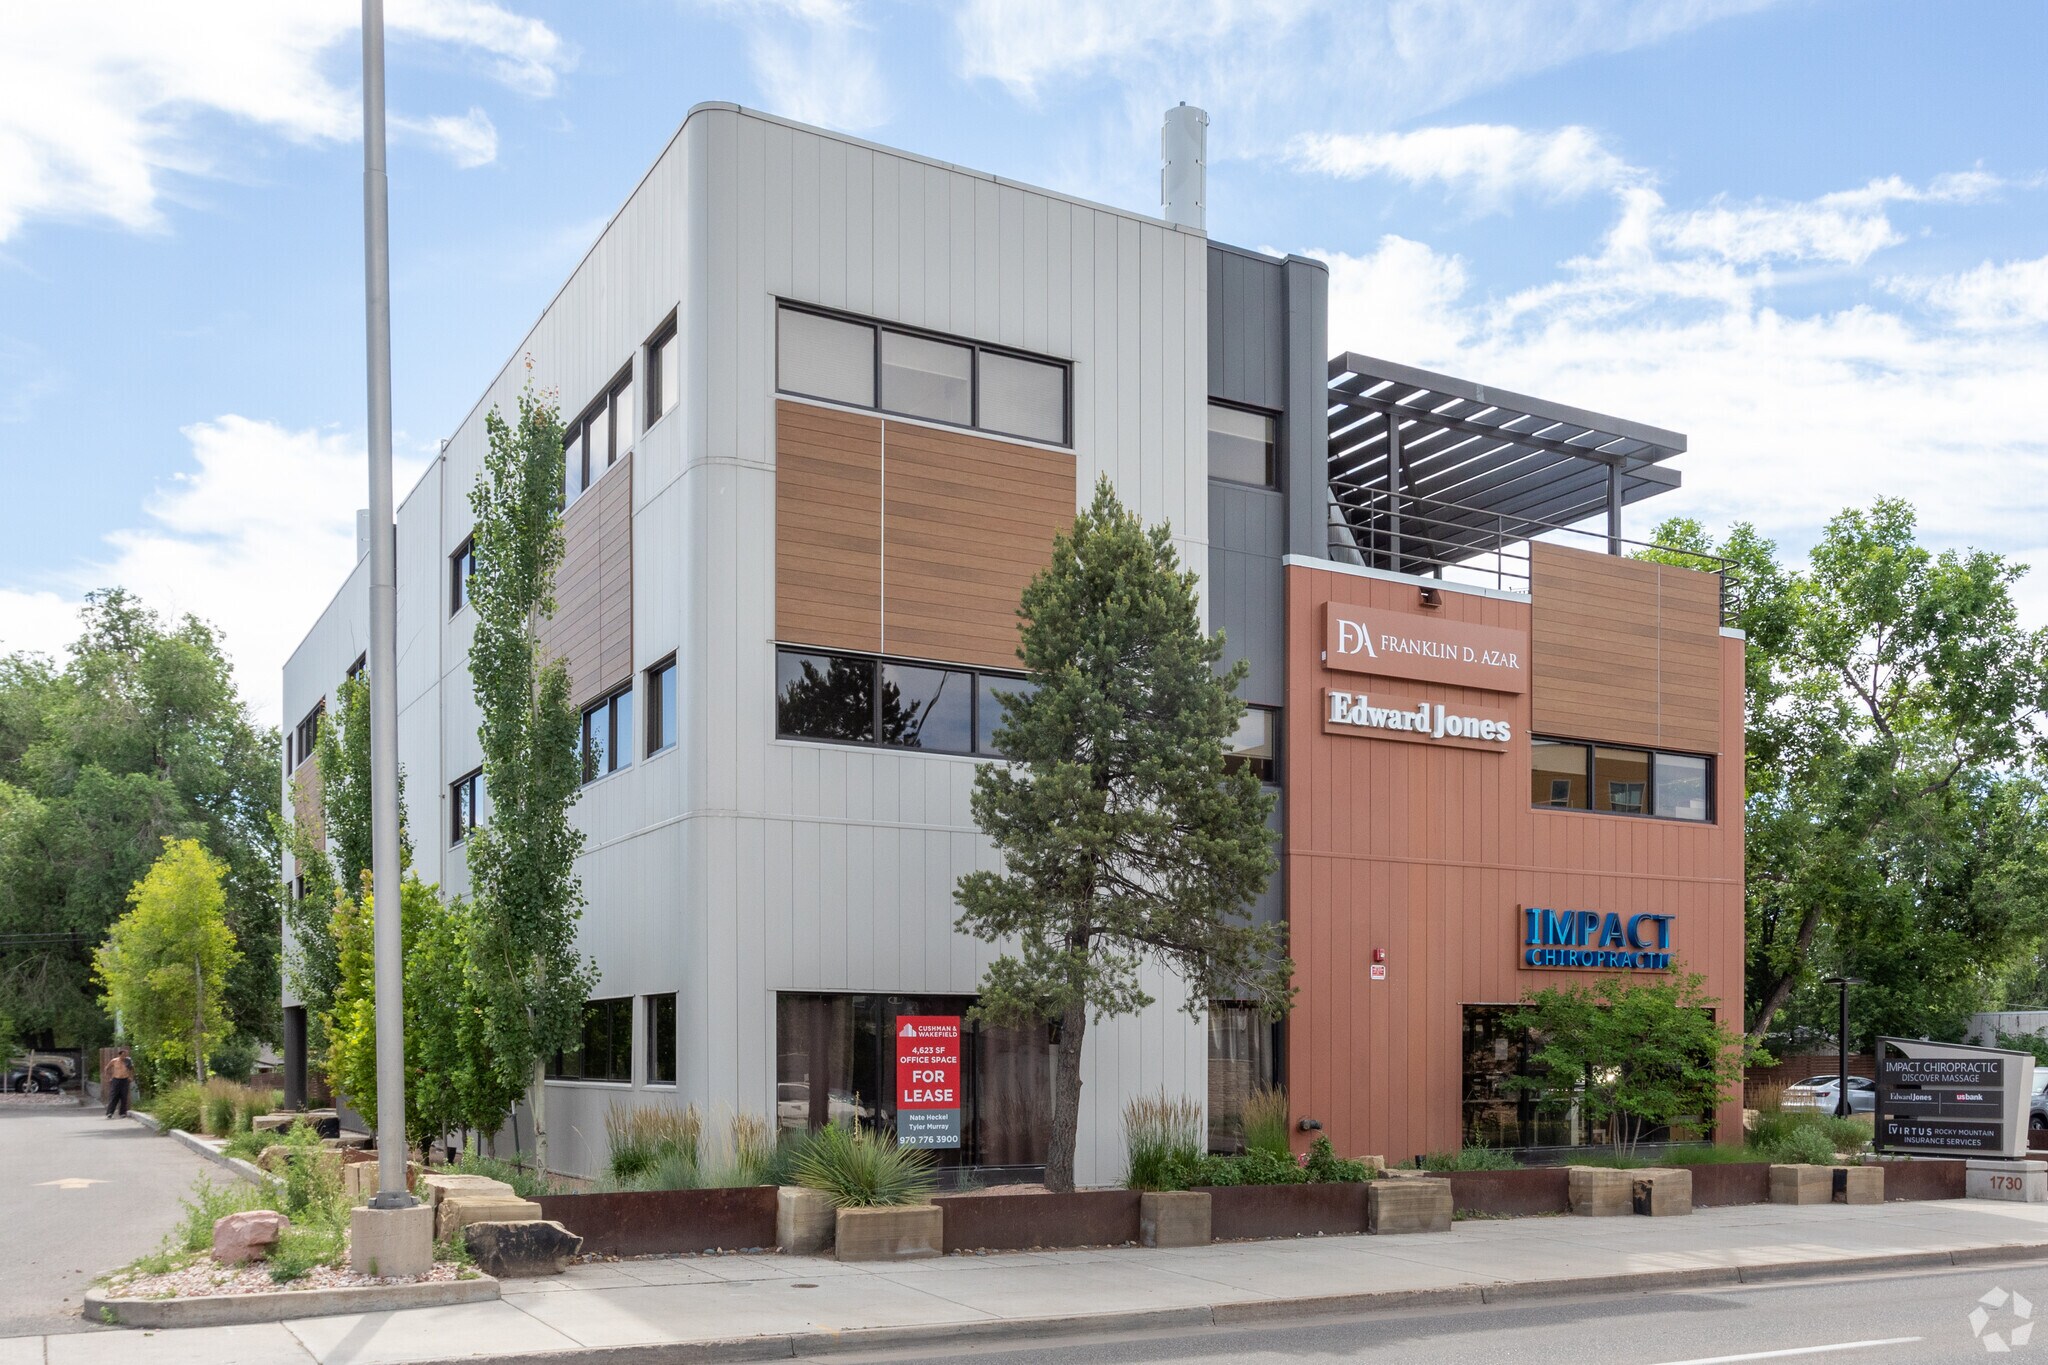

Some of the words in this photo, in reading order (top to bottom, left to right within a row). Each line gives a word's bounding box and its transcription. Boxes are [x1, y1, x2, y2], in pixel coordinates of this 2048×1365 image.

[1381, 635, 1457, 660] FRANKLIN
[1463, 647, 1477, 663] D.
[1481, 650, 1519, 669] AZAR
[1525, 908, 1675, 949] IMPACT
[1886, 1062, 1919, 1072] IMPACT
[1924, 1062, 1998, 1073] CHIROPRACTIC
[912, 1070, 944, 1083] FOR
[1902, 1074, 1940, 1082] DISCOVER
[1942, 1074, 1980, 1082] MASSAGE
[904, 1089, 953, 1102] LEASE
[1891, 1127, 1932, 1136] VIRTUS
[900, 1136, 916, 1144] 970
[1904, 1137, 1944, 1145] INSURANCE
[1946, 1138, 1982, 1146] SERVICES
[1990, 1176, 2022, 1190] 1730
